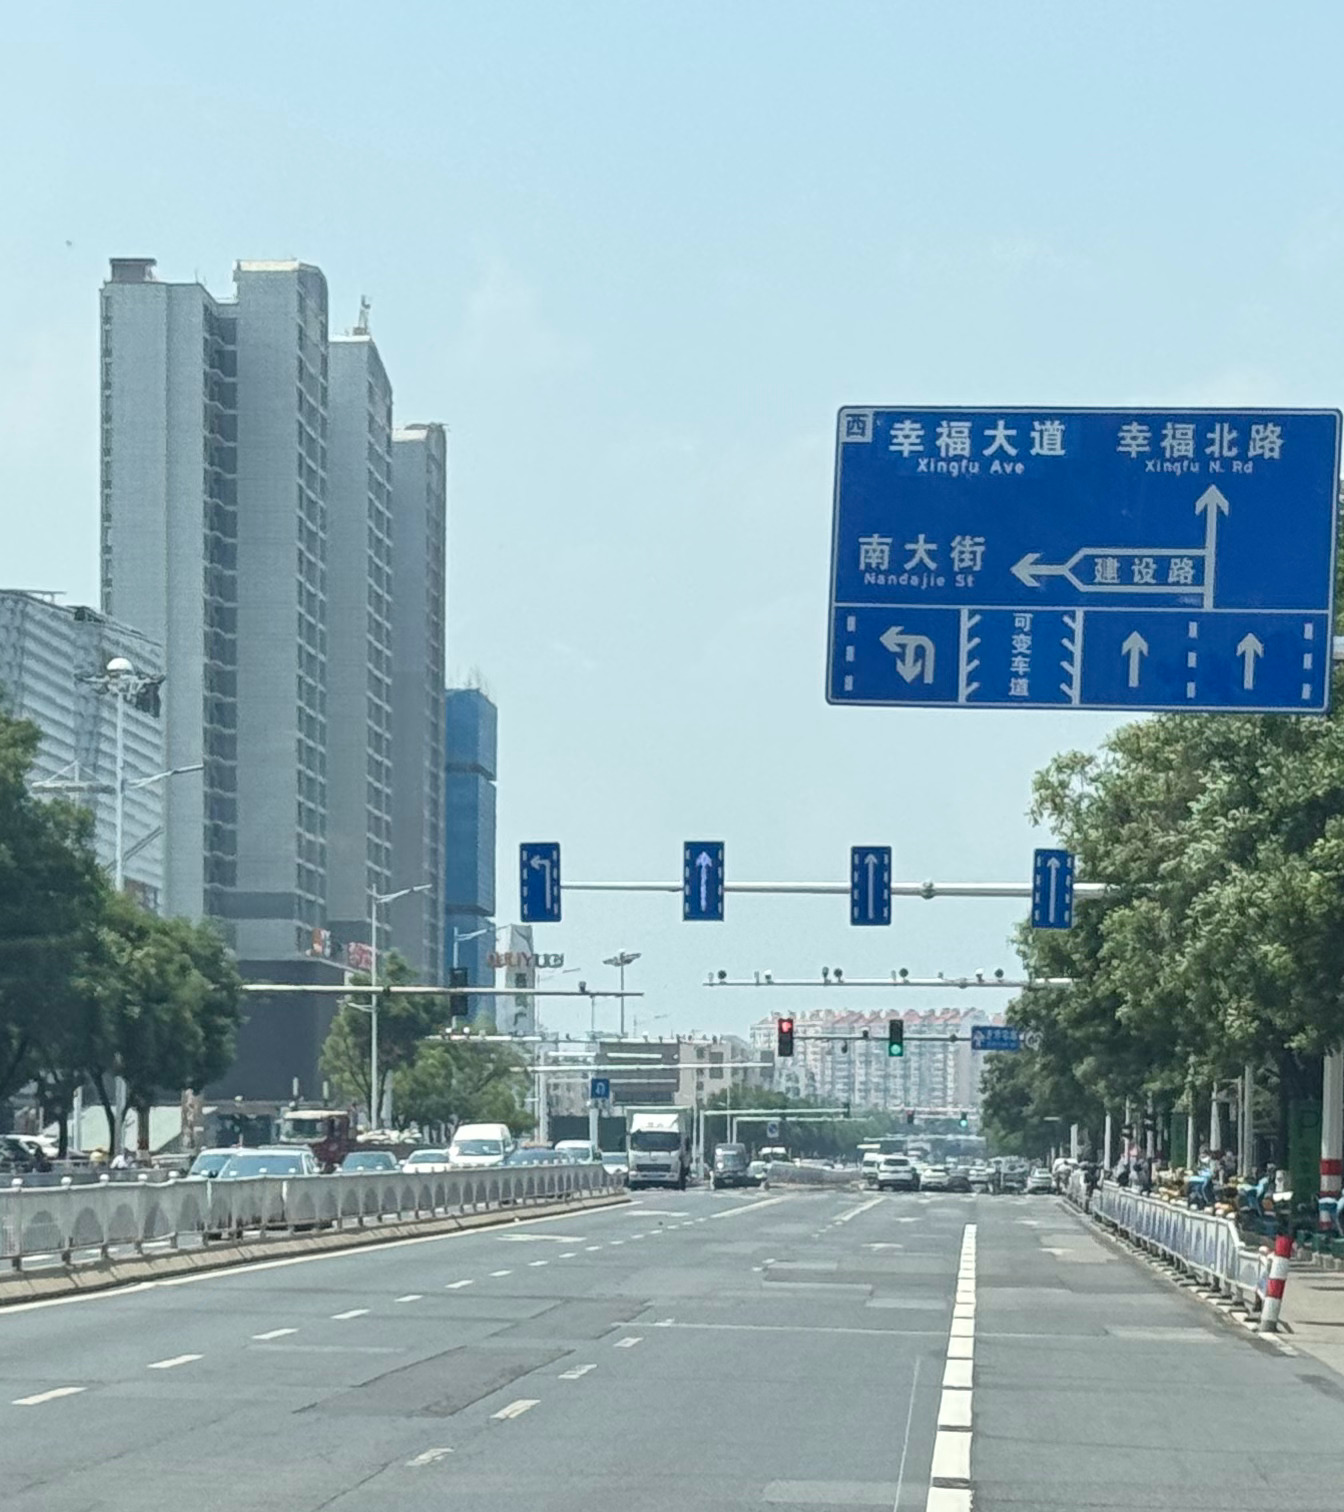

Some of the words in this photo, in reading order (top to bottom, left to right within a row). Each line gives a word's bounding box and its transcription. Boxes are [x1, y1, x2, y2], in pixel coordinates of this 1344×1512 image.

[845, 413, 867, 438] 西
[888, 419, 1067, 458] 幸福大道
[1116, 421, 1286, 460] 幸福北路
[917, 458, 980, 477] Xingfu
[990, 459, 1026, 475] Ave
[1145, 459, 1200, 476] Xingfu
[1232, 460, 1254, 474] Rd
[857, 533, 987, 572] 南大街
[864, 572, 946, 590] Nandajie
[955, 574, 976, 588] St
[1093, 556, 1197, 586] 建设路
[1009, 611, 1034, 697] 可变车道
